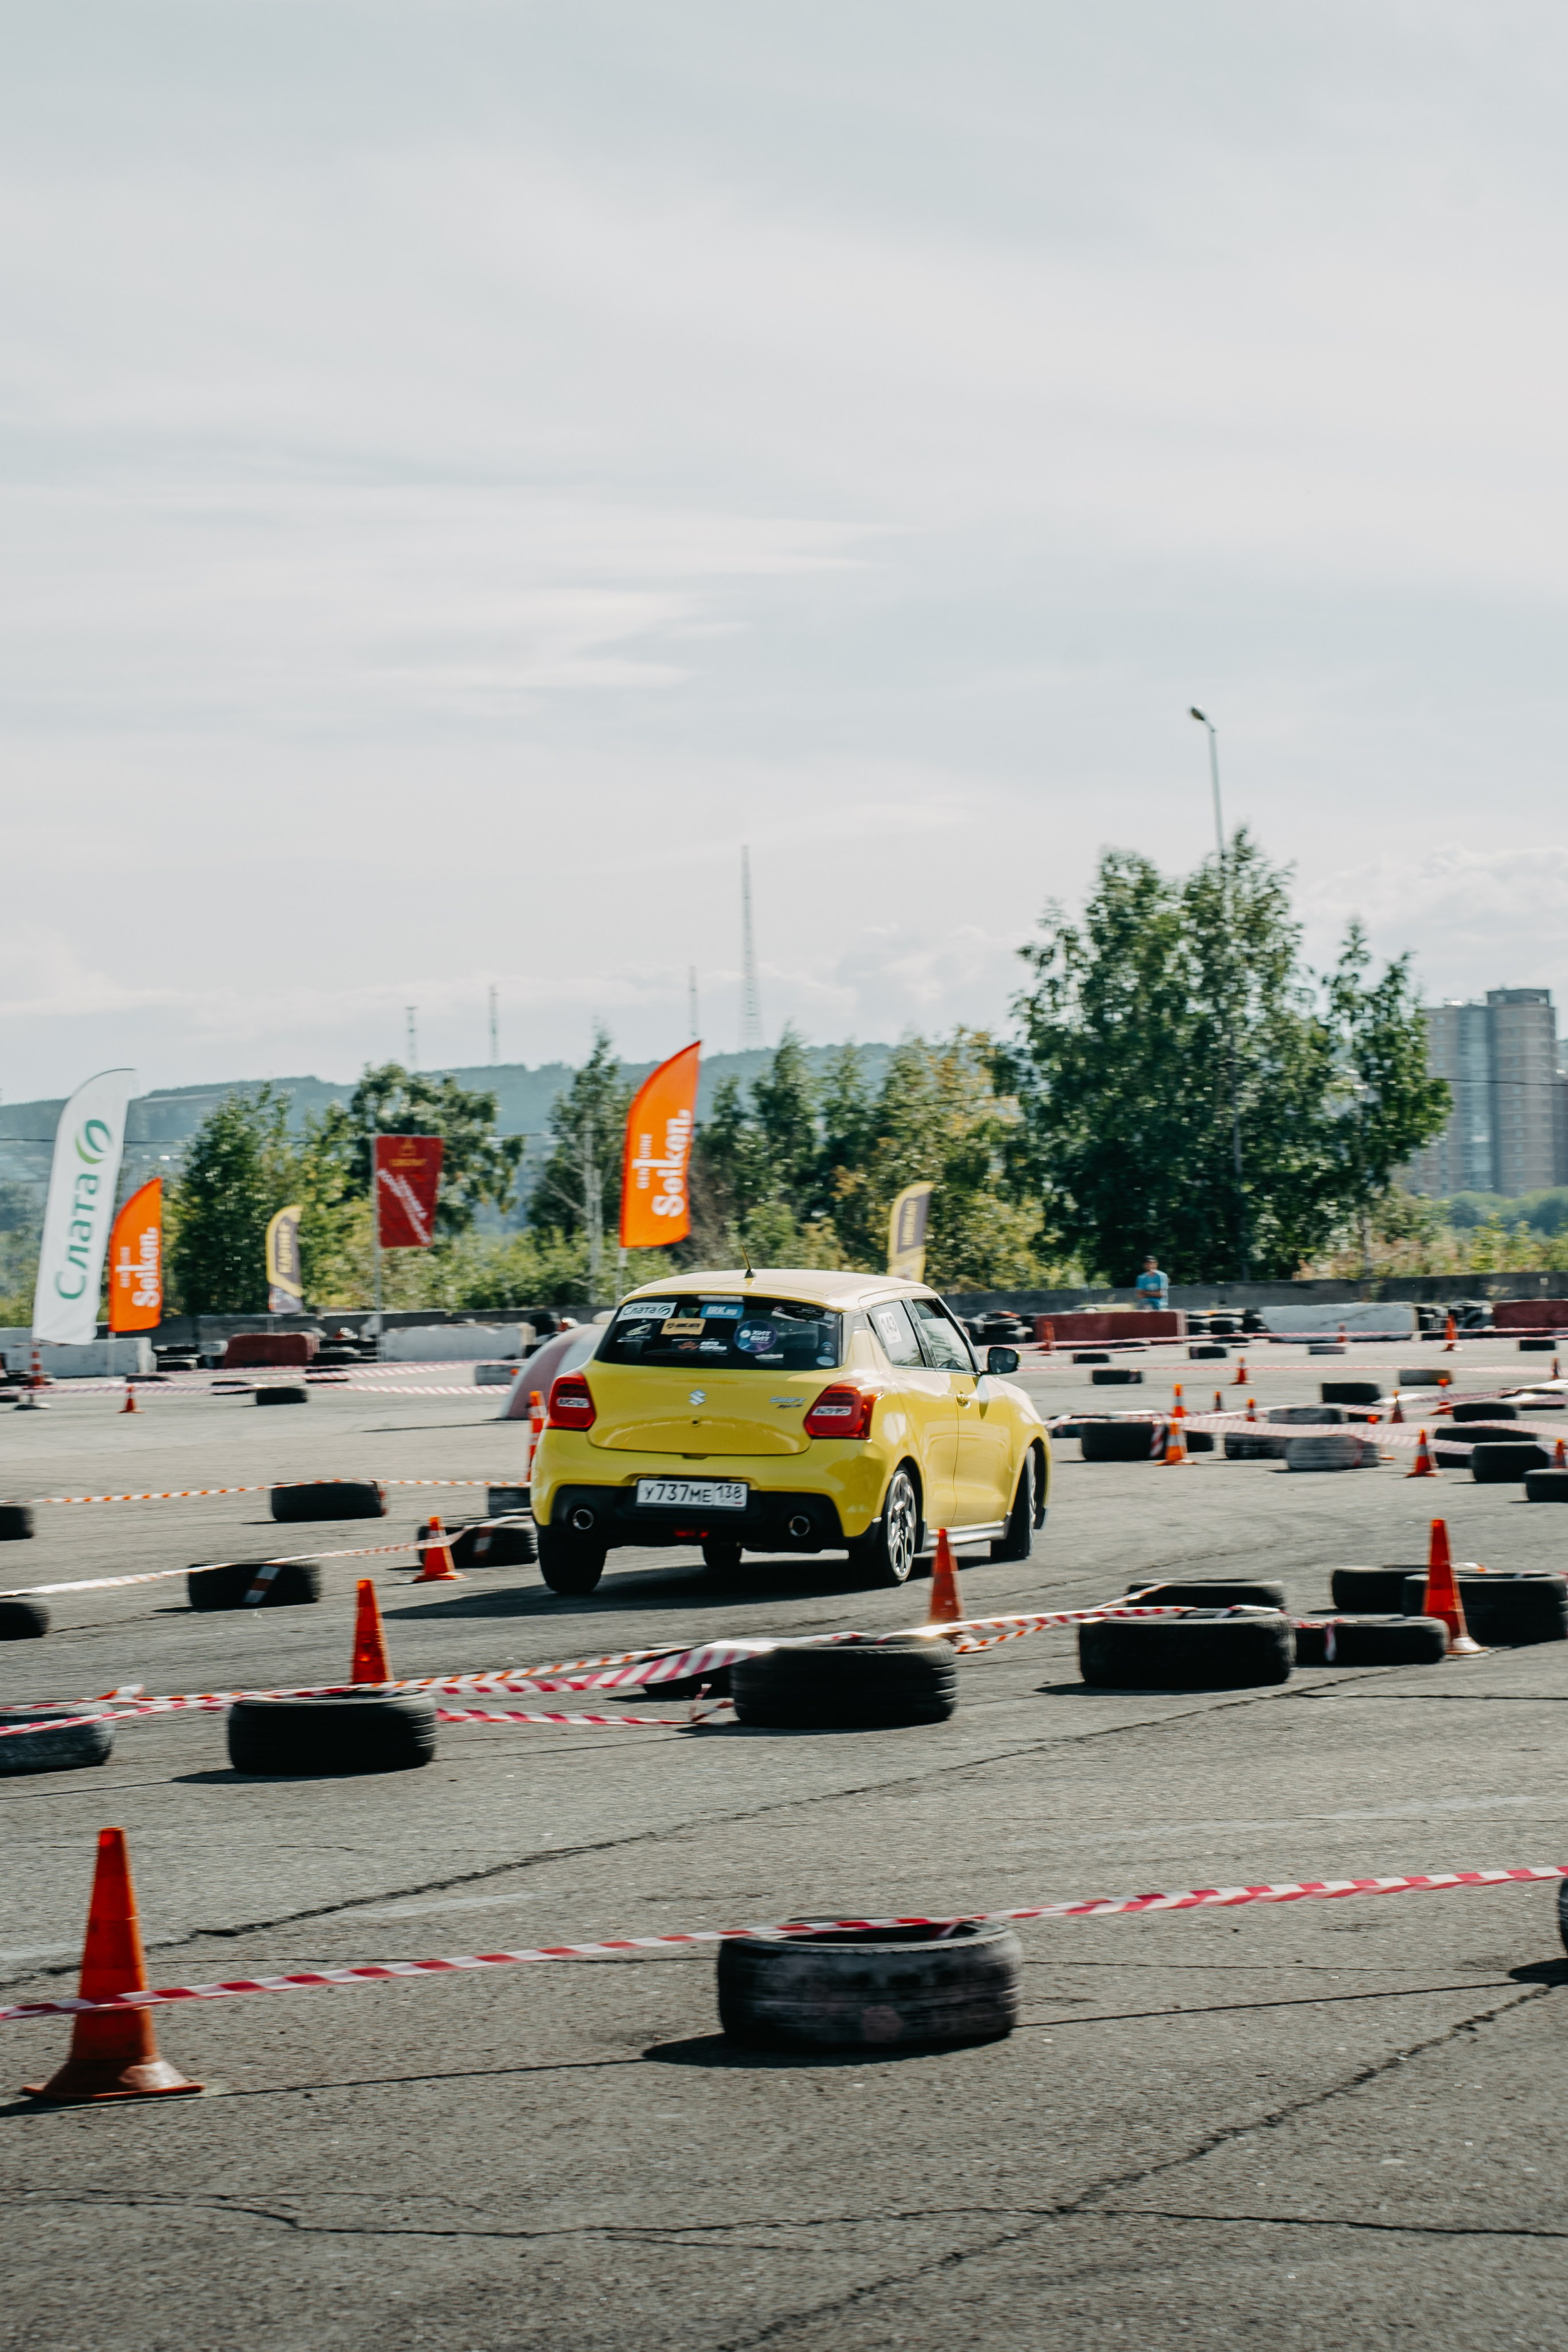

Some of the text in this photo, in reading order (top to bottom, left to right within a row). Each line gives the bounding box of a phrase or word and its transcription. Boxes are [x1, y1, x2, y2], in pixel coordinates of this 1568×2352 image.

[56, 1173, 100, 1299] Слата
[622, 1306, 657, 1316] Слата
[715, 1485, 743, 1499] 138
